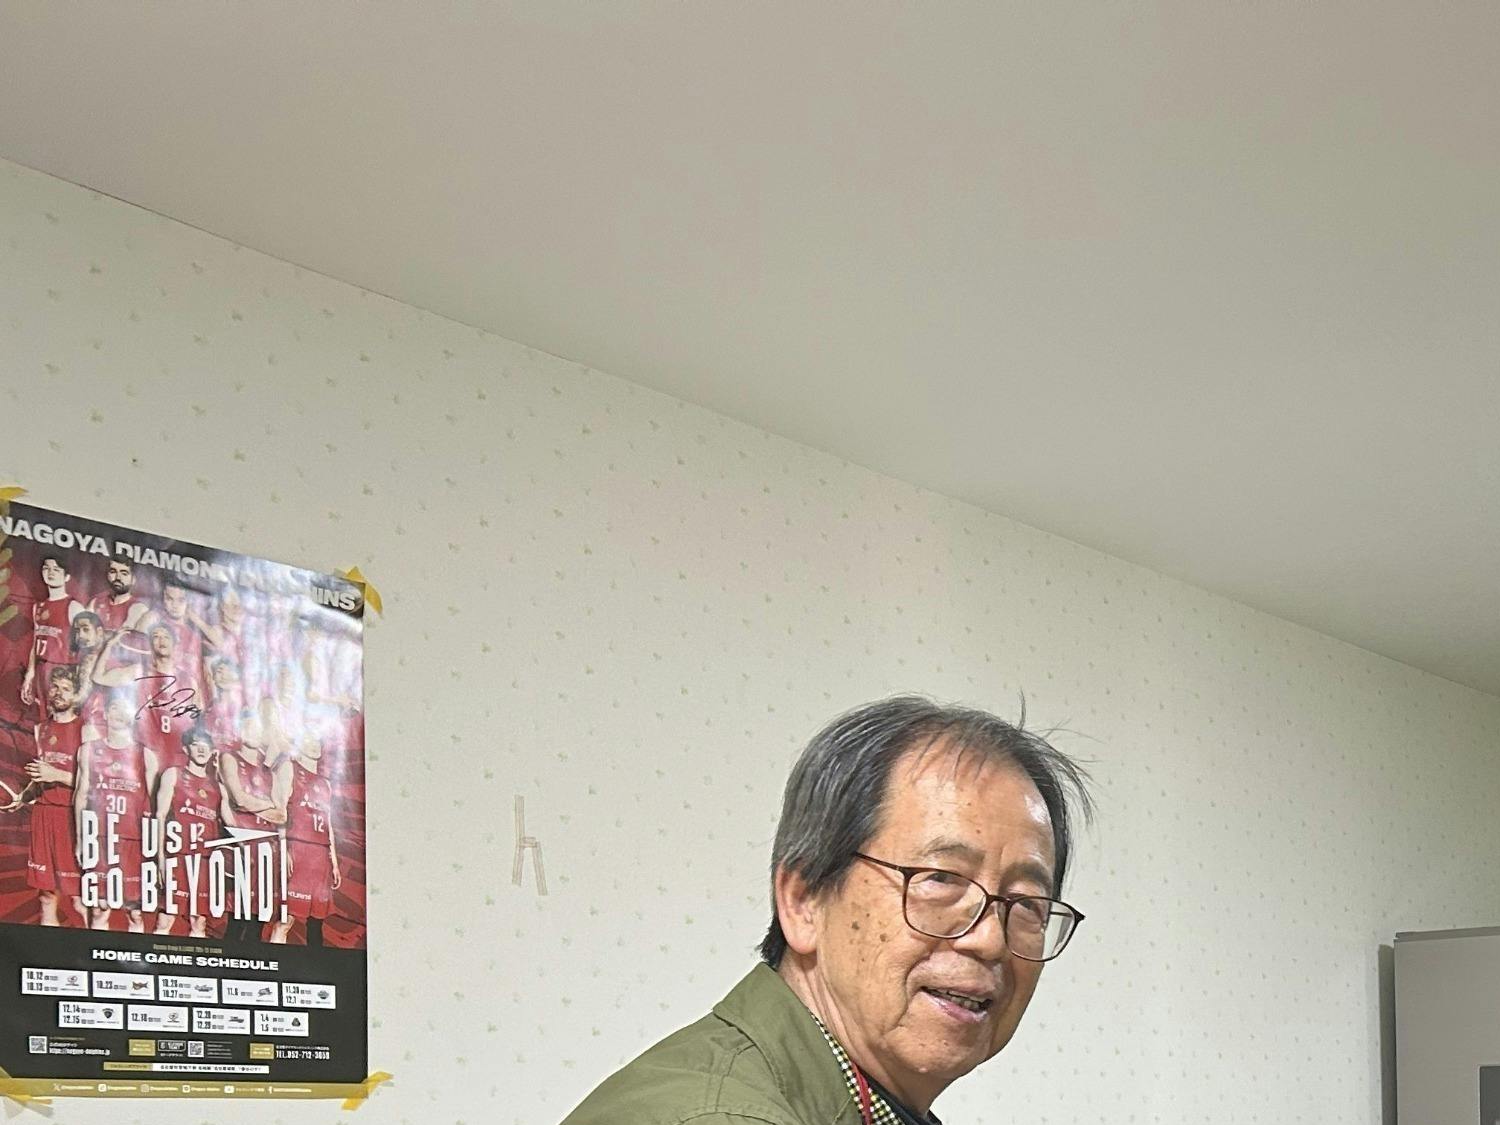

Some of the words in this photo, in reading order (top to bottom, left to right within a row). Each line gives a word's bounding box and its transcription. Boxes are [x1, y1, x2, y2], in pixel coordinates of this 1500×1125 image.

[0, 516, 110, 557] NAGOYA
[115, 541, 229, 583] DIAMON
[160, 715, 171, 734] 8
[106, 794, 126, 815] 30
[312, 814, 325, 833] 12
[82, 810, 120, 870] BE
[142, 817, 198, 857] US!
[81, 867, 123, 909] GO
[141, 838, 288, 924] BEYOND!
[92, 949, 141, 962] HOME
[145, 953, 192, 966] GAME
[196, 956, 279, 971] SCHEDULE
